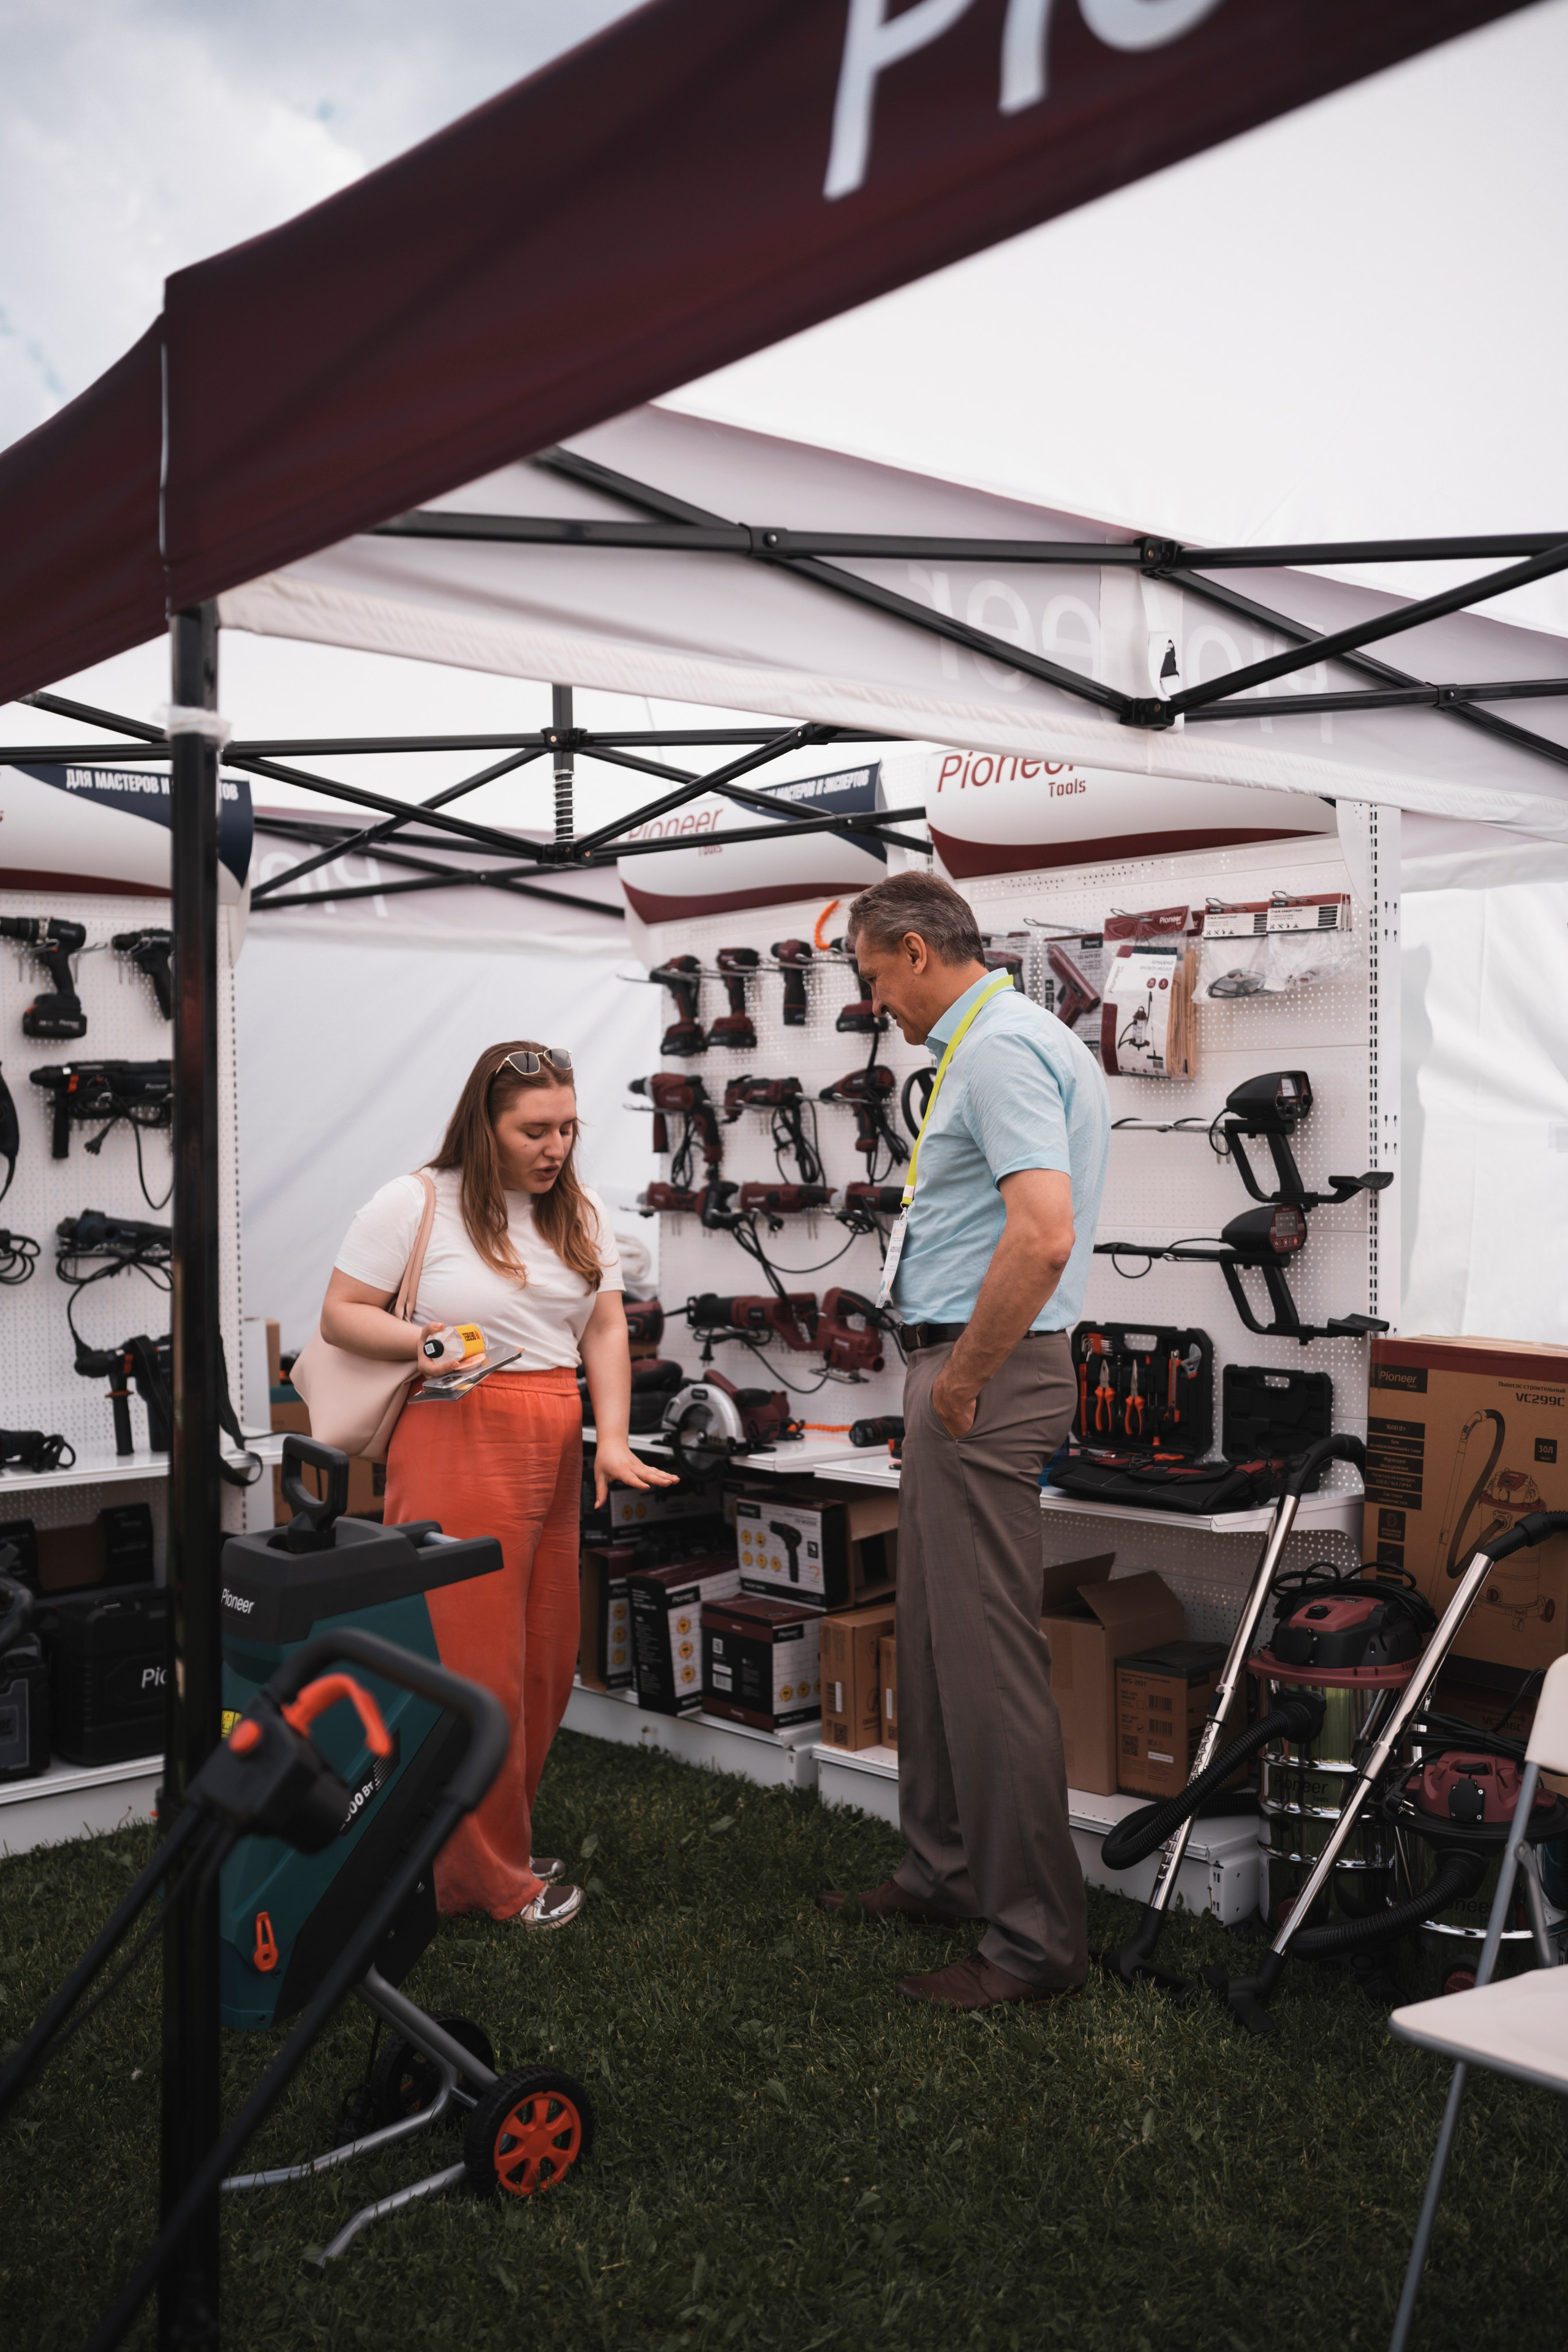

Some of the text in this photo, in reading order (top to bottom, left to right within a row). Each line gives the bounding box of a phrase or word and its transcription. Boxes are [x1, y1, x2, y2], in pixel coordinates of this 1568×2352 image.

[66, 769, 92, 790] ДЛЯ
[94, 771, 159, 794] МАСТЕРОВ
[160, 777, 170, 794] И
[937, 751, 1074, 793] Pione
[815, 778, 824, 796] И
[823, 769, 870, 794] ЭКСПЕРТОВ
[1049, 778, 1085, 797] Tools
[1159, 916, 1182, 924] Pioneer
[1379, 1371, 1417, 1384] Pioneer
[1516, 1392, 1565, 1406] VC299C
[1523, 1385, 1566, 1393] строительный
[222, 1588, 255, 1615] Pioneer
[1274, 1773, 1328, 1794] Pioneer
